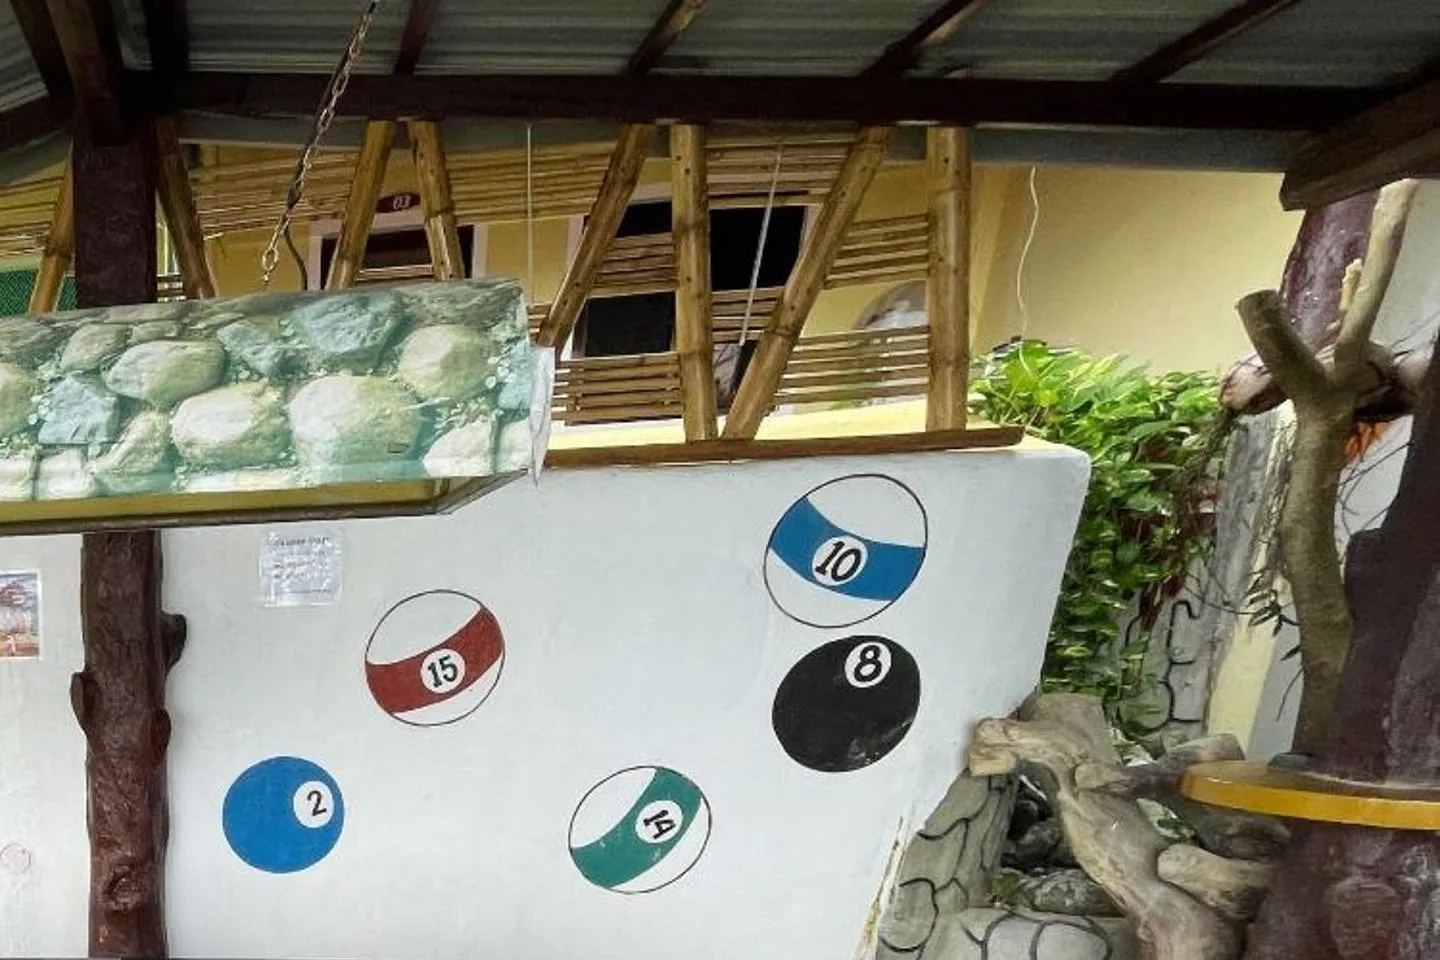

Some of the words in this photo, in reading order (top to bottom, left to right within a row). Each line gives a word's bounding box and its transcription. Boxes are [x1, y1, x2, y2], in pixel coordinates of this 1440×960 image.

[815, 541, 862, 582] 10
[427, 654, 458, 688] 15
[853, 644, 882, 683] 8
[307, 790, 327, 816] 2
[643, 810, 676, 839] 14
